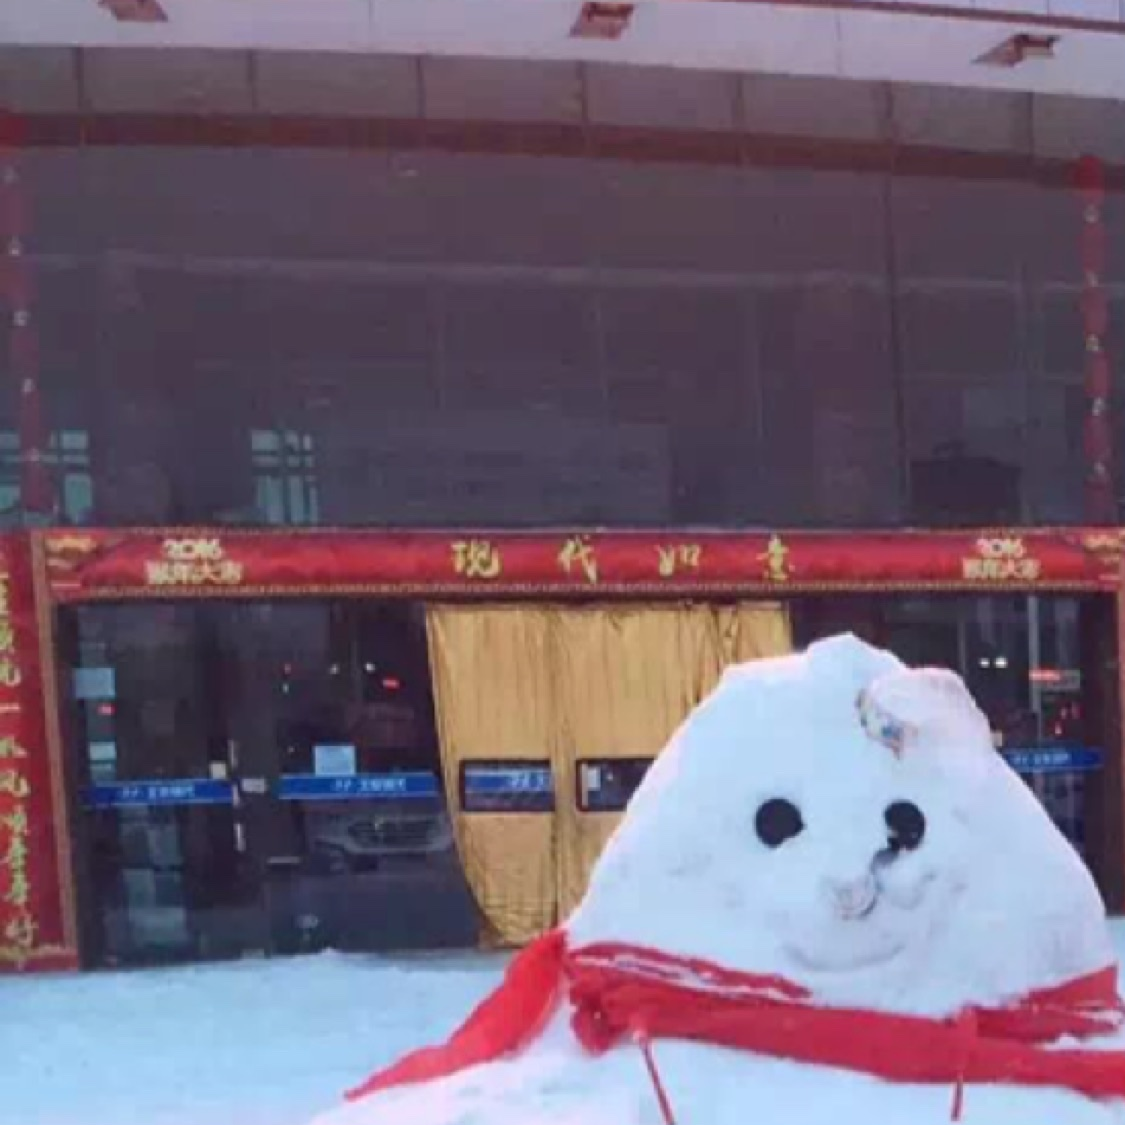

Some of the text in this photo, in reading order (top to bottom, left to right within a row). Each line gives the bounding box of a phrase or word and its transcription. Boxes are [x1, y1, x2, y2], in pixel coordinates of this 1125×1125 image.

[163, 538, 225, 560] 2016
[449, 533, 796, 583] 现代如意
